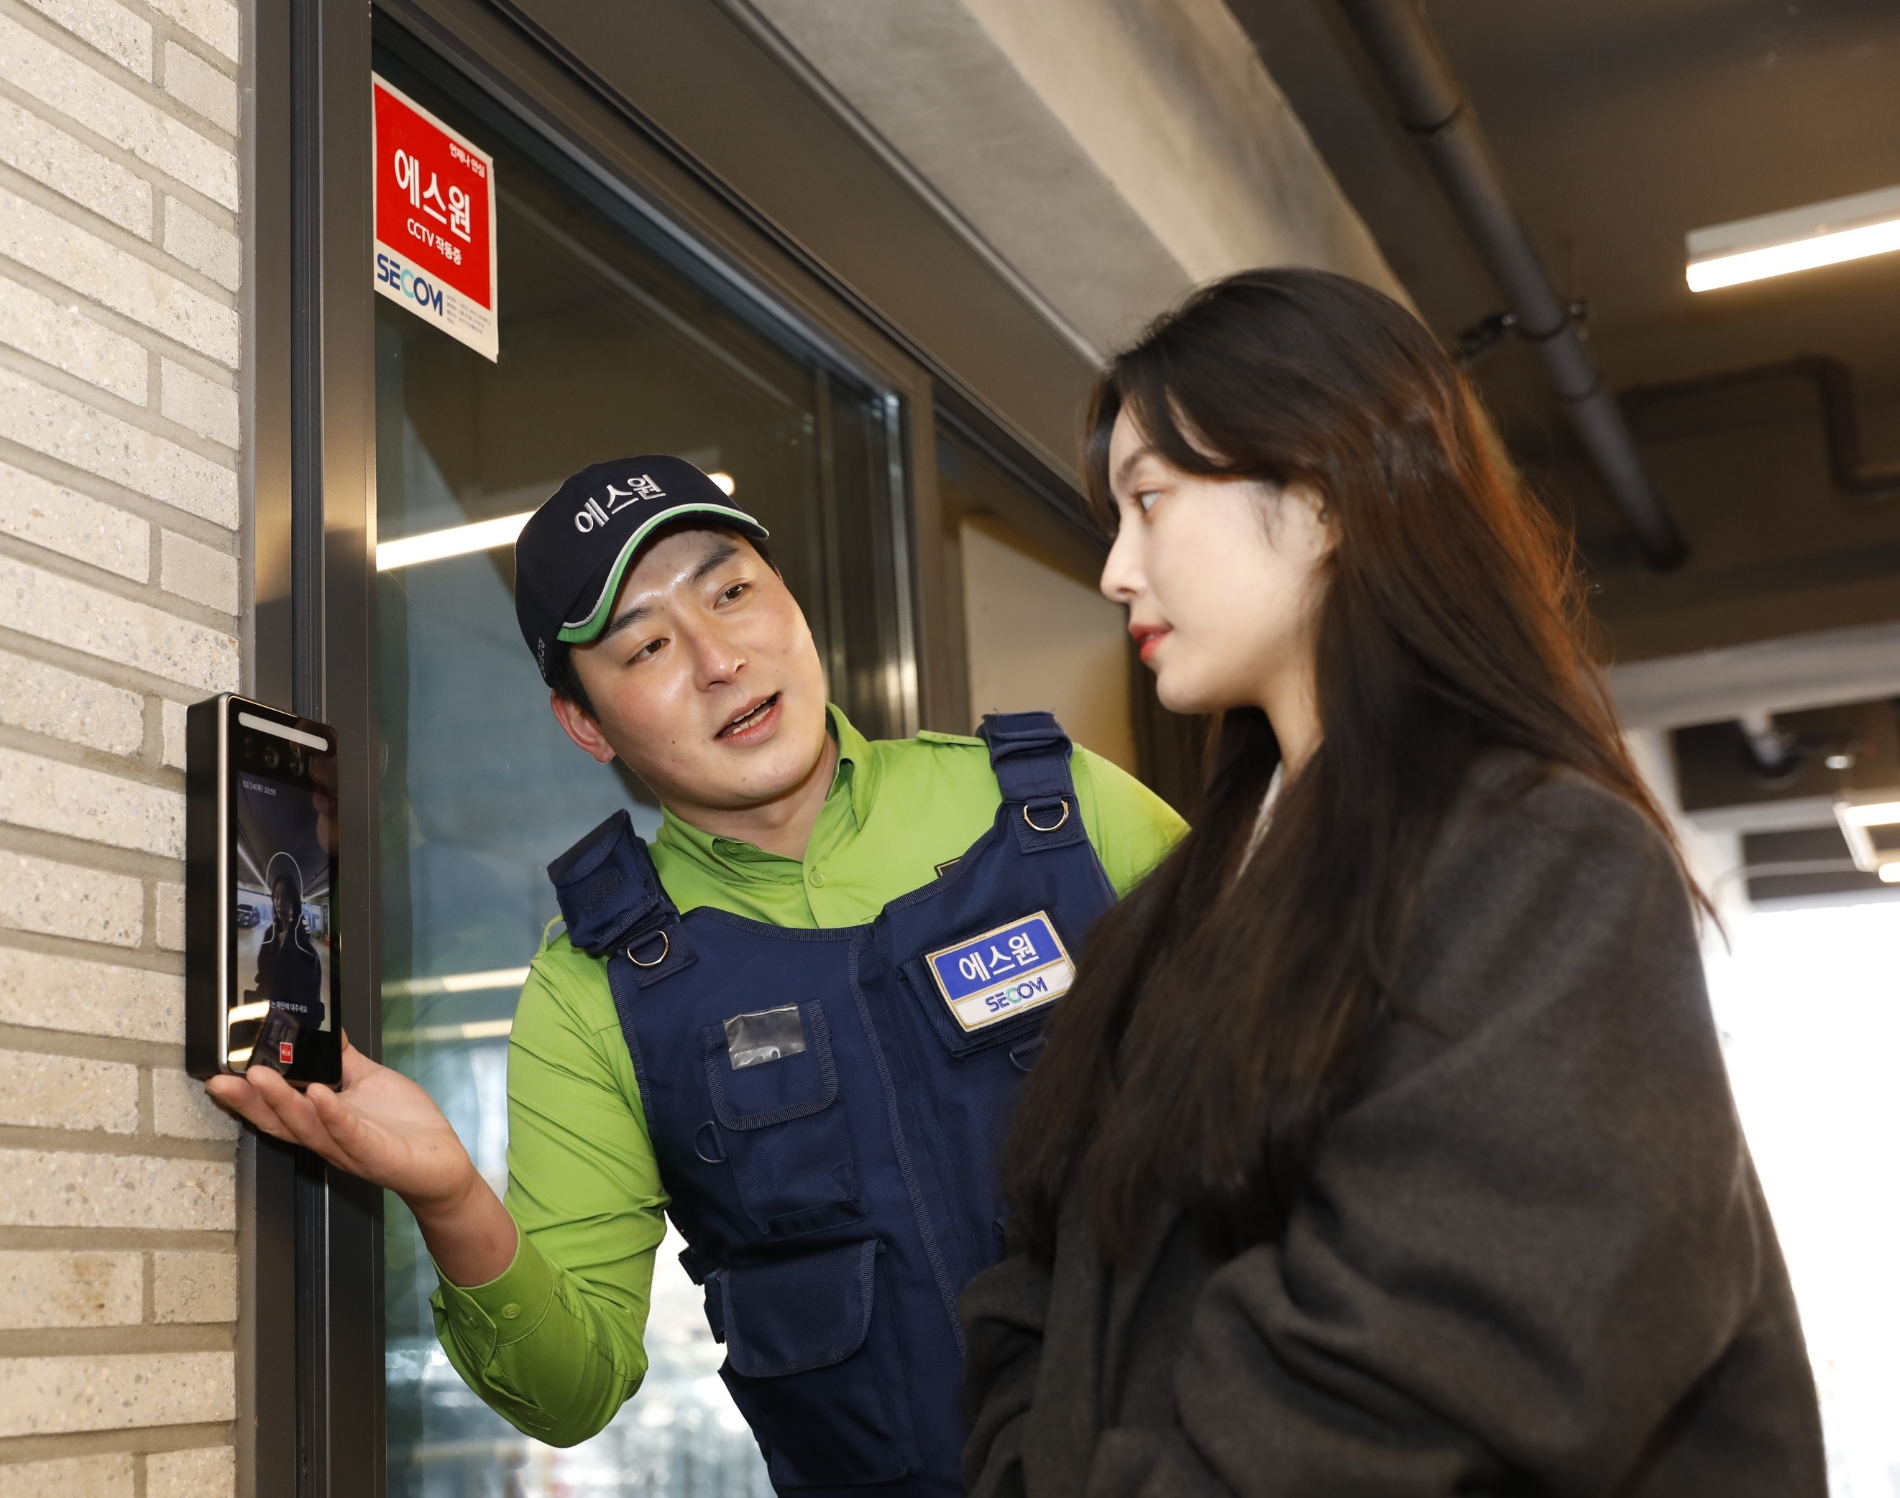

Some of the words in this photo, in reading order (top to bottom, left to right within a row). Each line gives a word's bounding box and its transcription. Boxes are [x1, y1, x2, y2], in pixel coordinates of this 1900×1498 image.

[449, 142, 470, 168] 언제나
[470, 158, 485, 179] 안심
[393, 148, 472, 243] 에스원
[406, 217, 434, 248] CCTV
[435, 235, 463, 266] 작동중
[376, 252, 443, 317] SECOM
[573, 473, 667, 534] 에스원
[958, 931, 1040, 982] 에스원
[984, 976, 1048, 1013] SECOM
